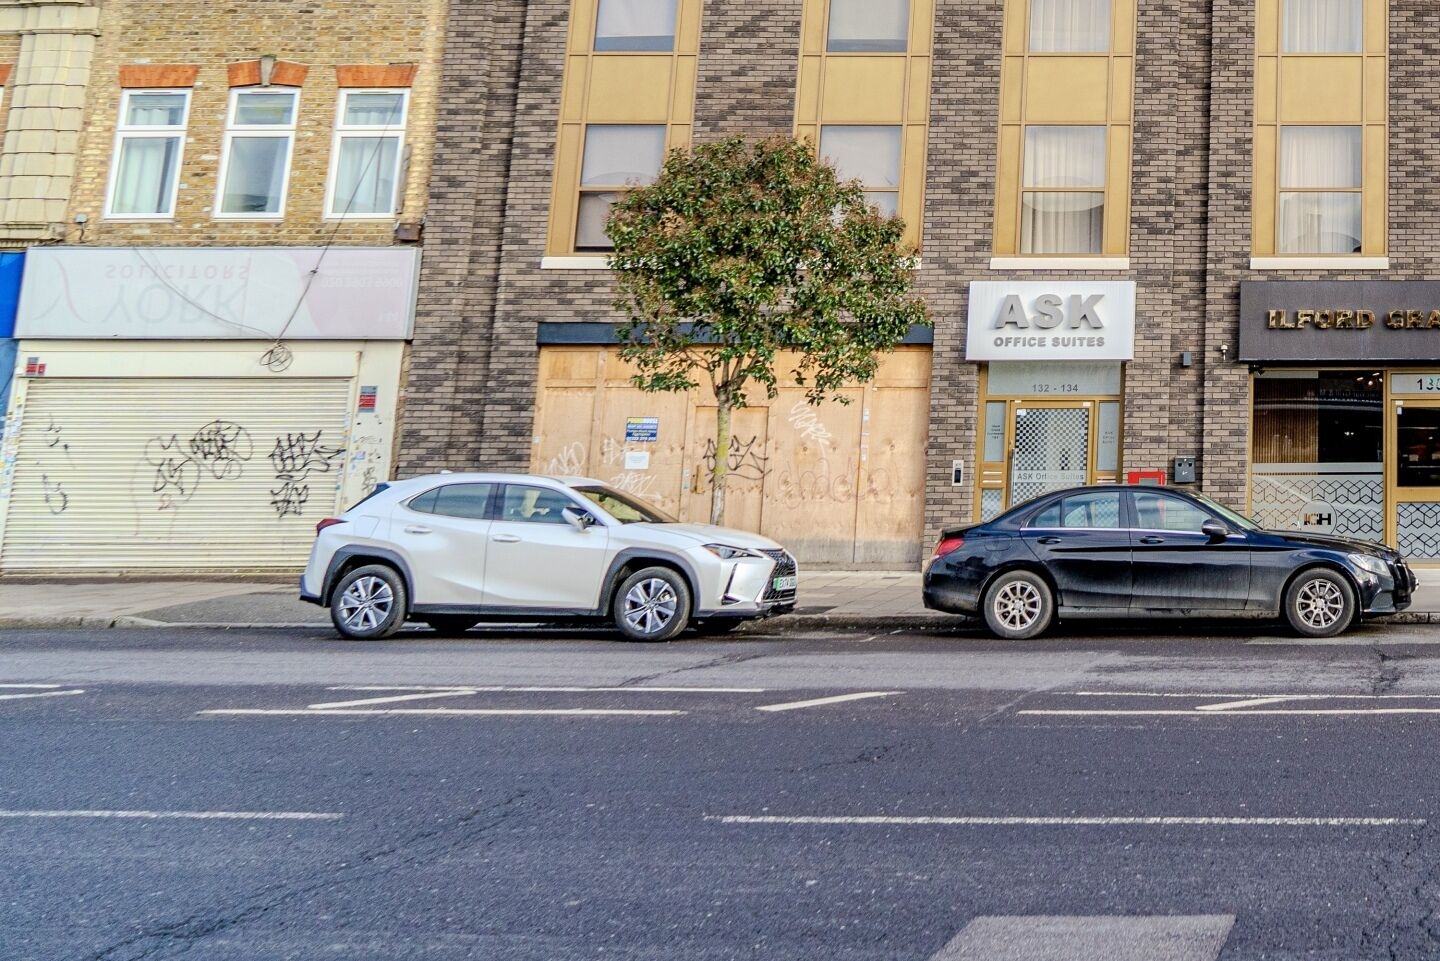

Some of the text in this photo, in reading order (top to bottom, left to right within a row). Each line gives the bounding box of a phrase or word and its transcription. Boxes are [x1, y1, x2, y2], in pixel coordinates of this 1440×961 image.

[994, 294, 1105, 329] ASK
[1267, 309, 1376, 329] ILFORD
[994, 336, 1105, 348] OFFICE SUITES
[1032, 384, 1049, 393] 132
[1060, 384, 1079, 392] 134
